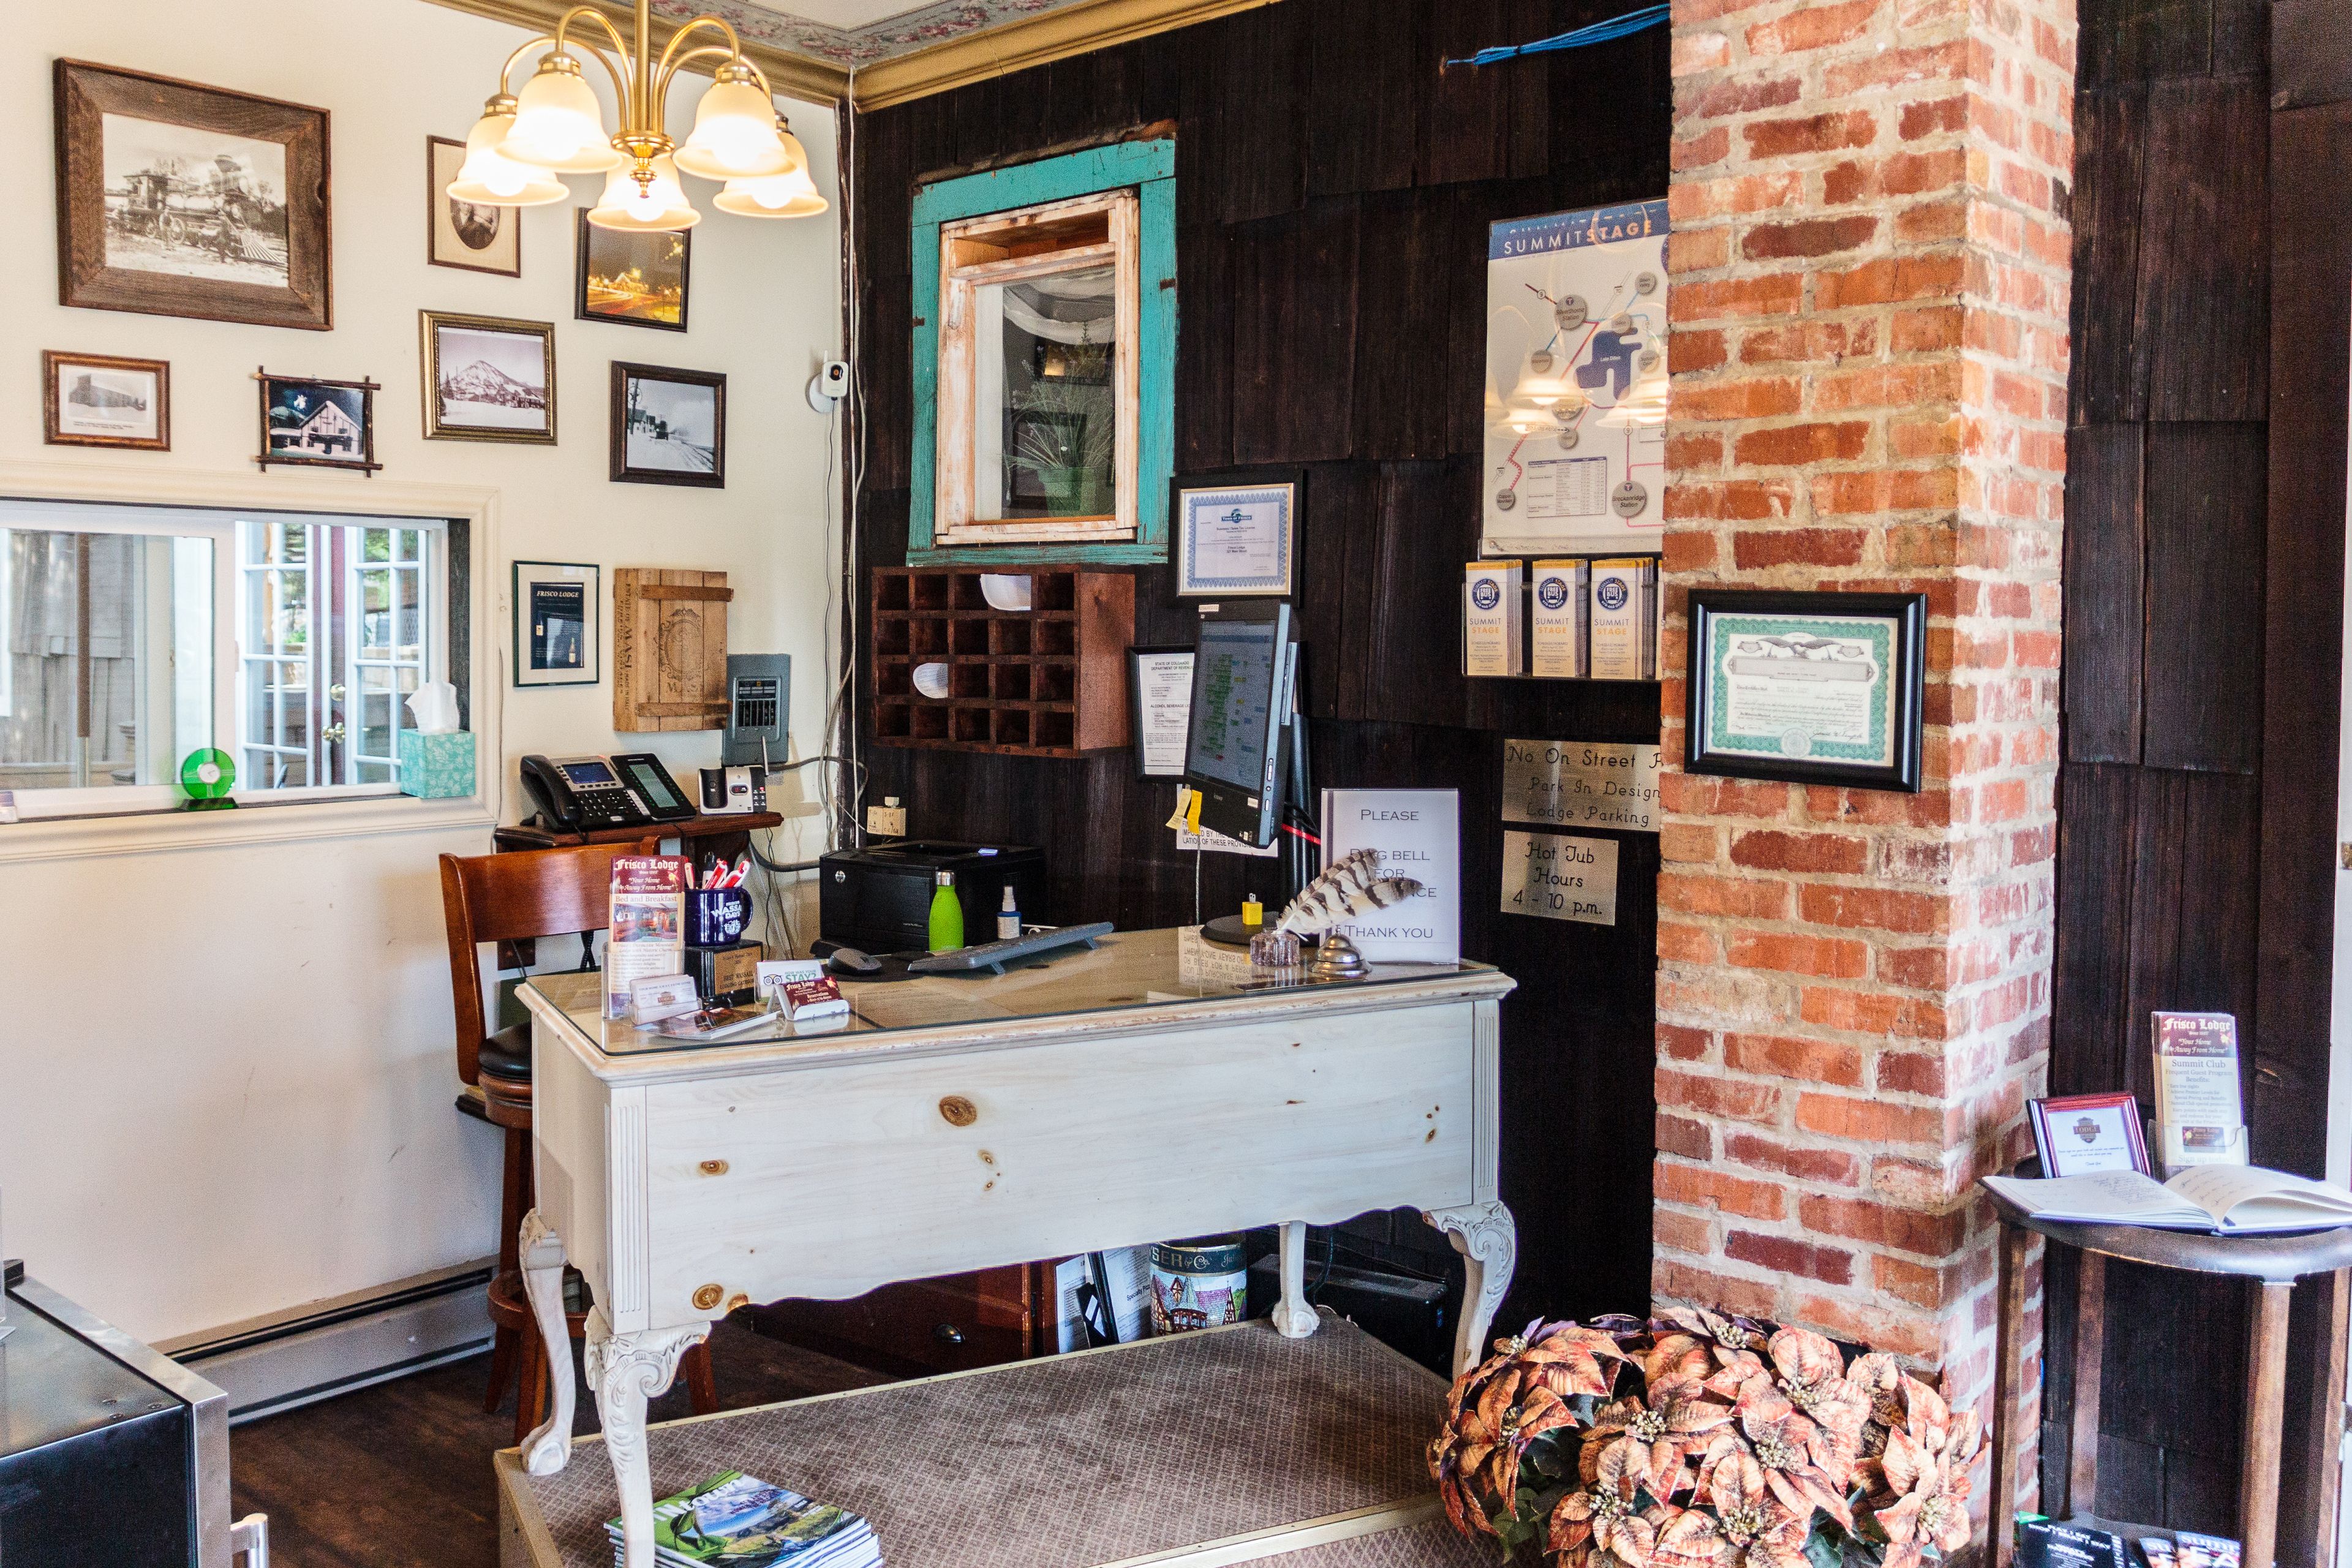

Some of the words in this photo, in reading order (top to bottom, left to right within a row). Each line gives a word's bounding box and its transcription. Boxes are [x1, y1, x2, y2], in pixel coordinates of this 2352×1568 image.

[624, 625, 633, 669] MASI
[1506, 745, 1533, 763] No
[1545, 747, 1570, 765] On
[1583, 749, 1636, 768] Street
[1528, 776, 1568, 793] Park
[1360, 809, 1419, 821] PLEASE
[1526, 804, 1574, 821] Lodge
[1584, 805, 1649, 827] Parking
[1392, 851, 1430, 861] BELL
[1525, 842, 1556, 860] Hot
[1566, 845, 1594, 864] Tub
[613, 859, 646, 870] Frisco
[649, 859, 679, 870] Lodge
[1375, 869, 1405, 878] FOR
[1533, 867, 1583, 888] Hours
[1513, 889, 1523, 905] 4
[1549, 892, 1564, 910] 10
[1573, 901, 1602, 916] p.m.
[1346, 925, 1398, 938] THANK
[1401, 927, 1433, 938] YOU
[2162, 1017, 2196, 1031] Frisco
[2198, 1018, 2231, 1031] Lodge
[2206, 1060, 2226, 1068] Club
